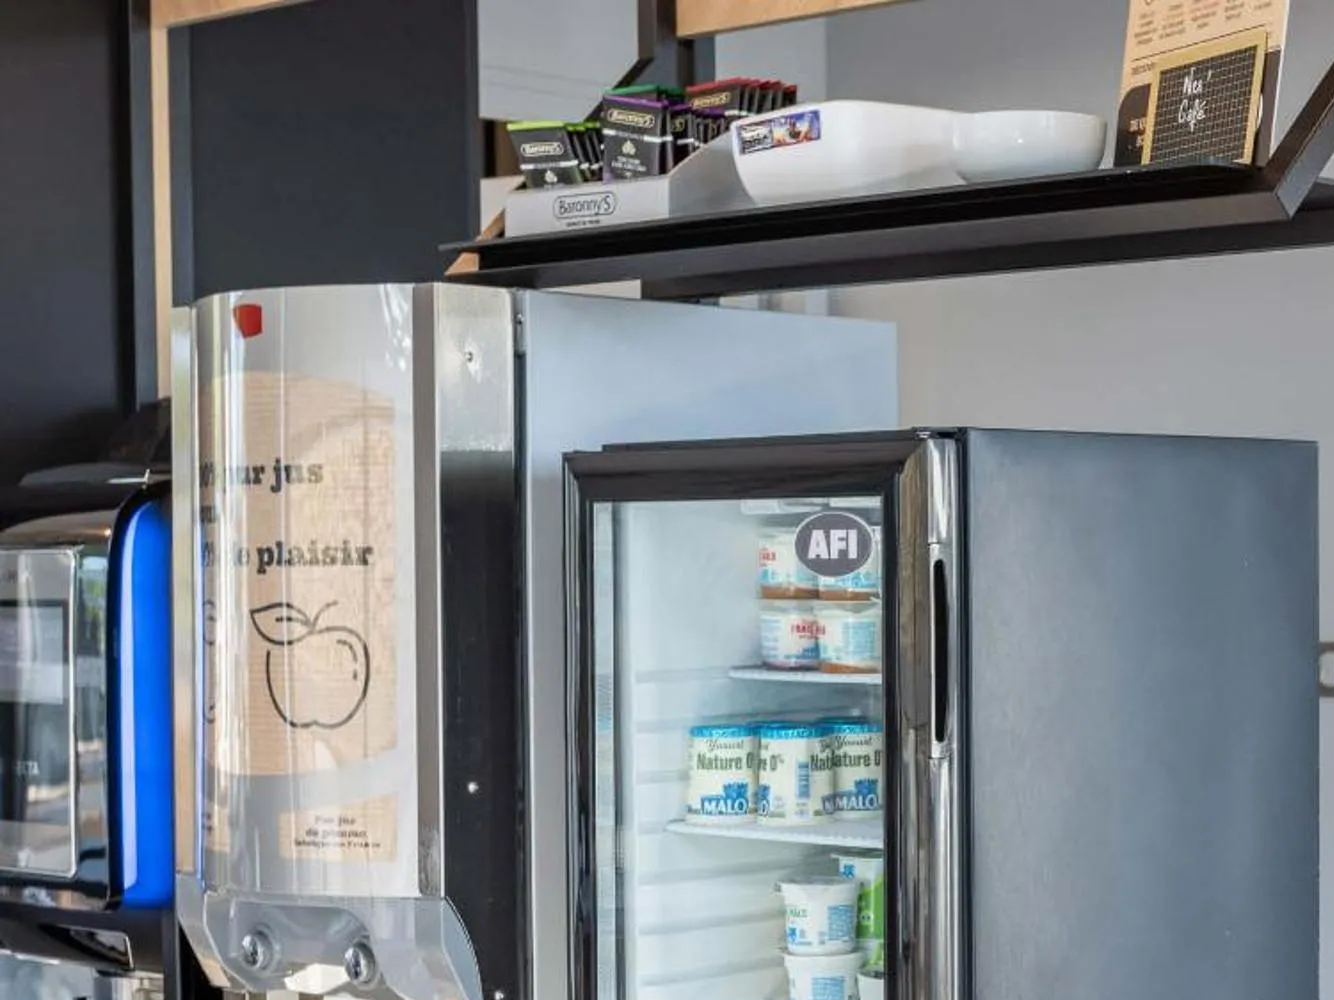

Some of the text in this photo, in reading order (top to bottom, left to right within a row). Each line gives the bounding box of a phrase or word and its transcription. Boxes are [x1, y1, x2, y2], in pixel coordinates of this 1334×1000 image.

[270, 457, 324, 493] jus
[256, 540, 374, 575] plaisir
[808, 529, 858, 560] AFI
[696, 752, 743, 771] Nature
[702, 797, 748, 814] MALO
